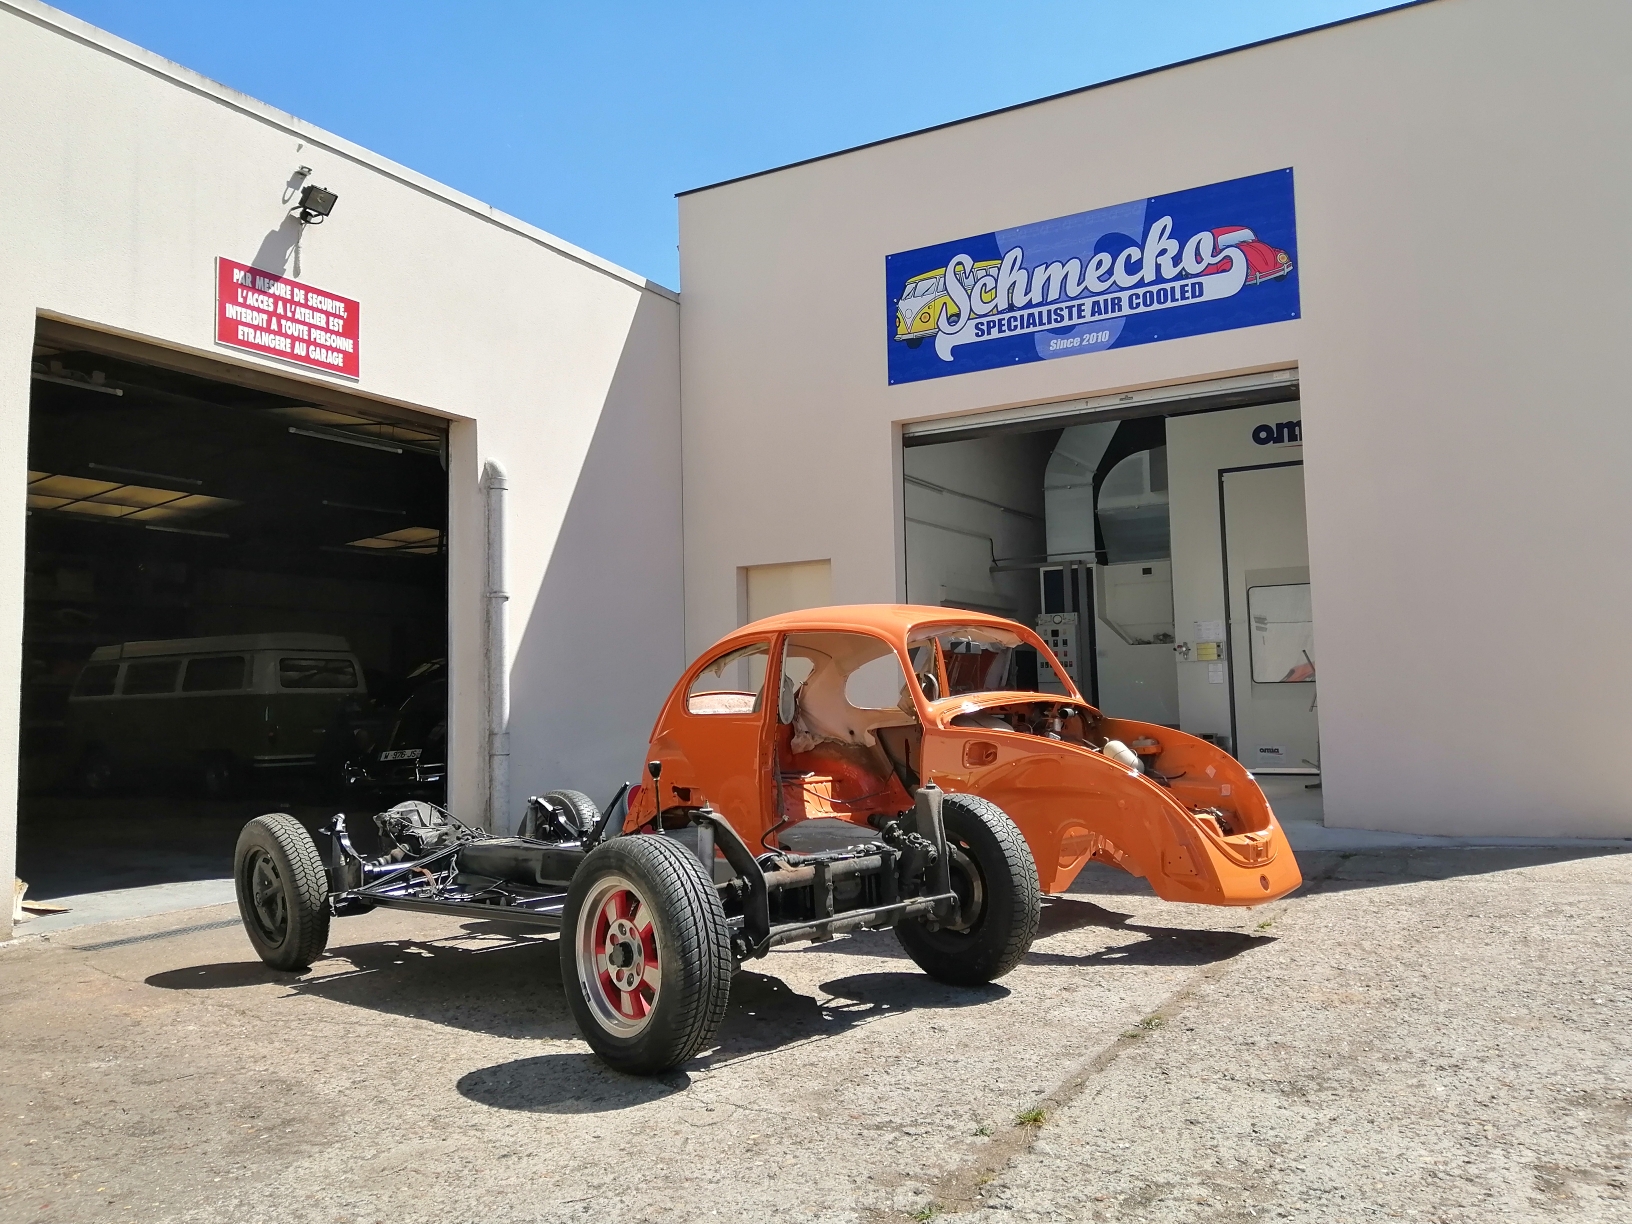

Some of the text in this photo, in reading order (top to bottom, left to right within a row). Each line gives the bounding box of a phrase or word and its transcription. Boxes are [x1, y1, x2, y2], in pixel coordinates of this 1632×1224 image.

[233, 269, 347, 318] PAR MESURE DE SECURITE,
[937, 215, 1247, 336] Schmecko
[226, 303, 353, 353] INTERDIT A TOUTE PERSONNE
[238, 288, 343, 332] L'ACCES A L'ATELIER EST
[975, 282, 1203, 338] SPECIALISTE AIR COOLED
[238, 325, 343, 367] ETRANGERE AU GARAGE
[1050, 330, 1109, 350] Since 2010
